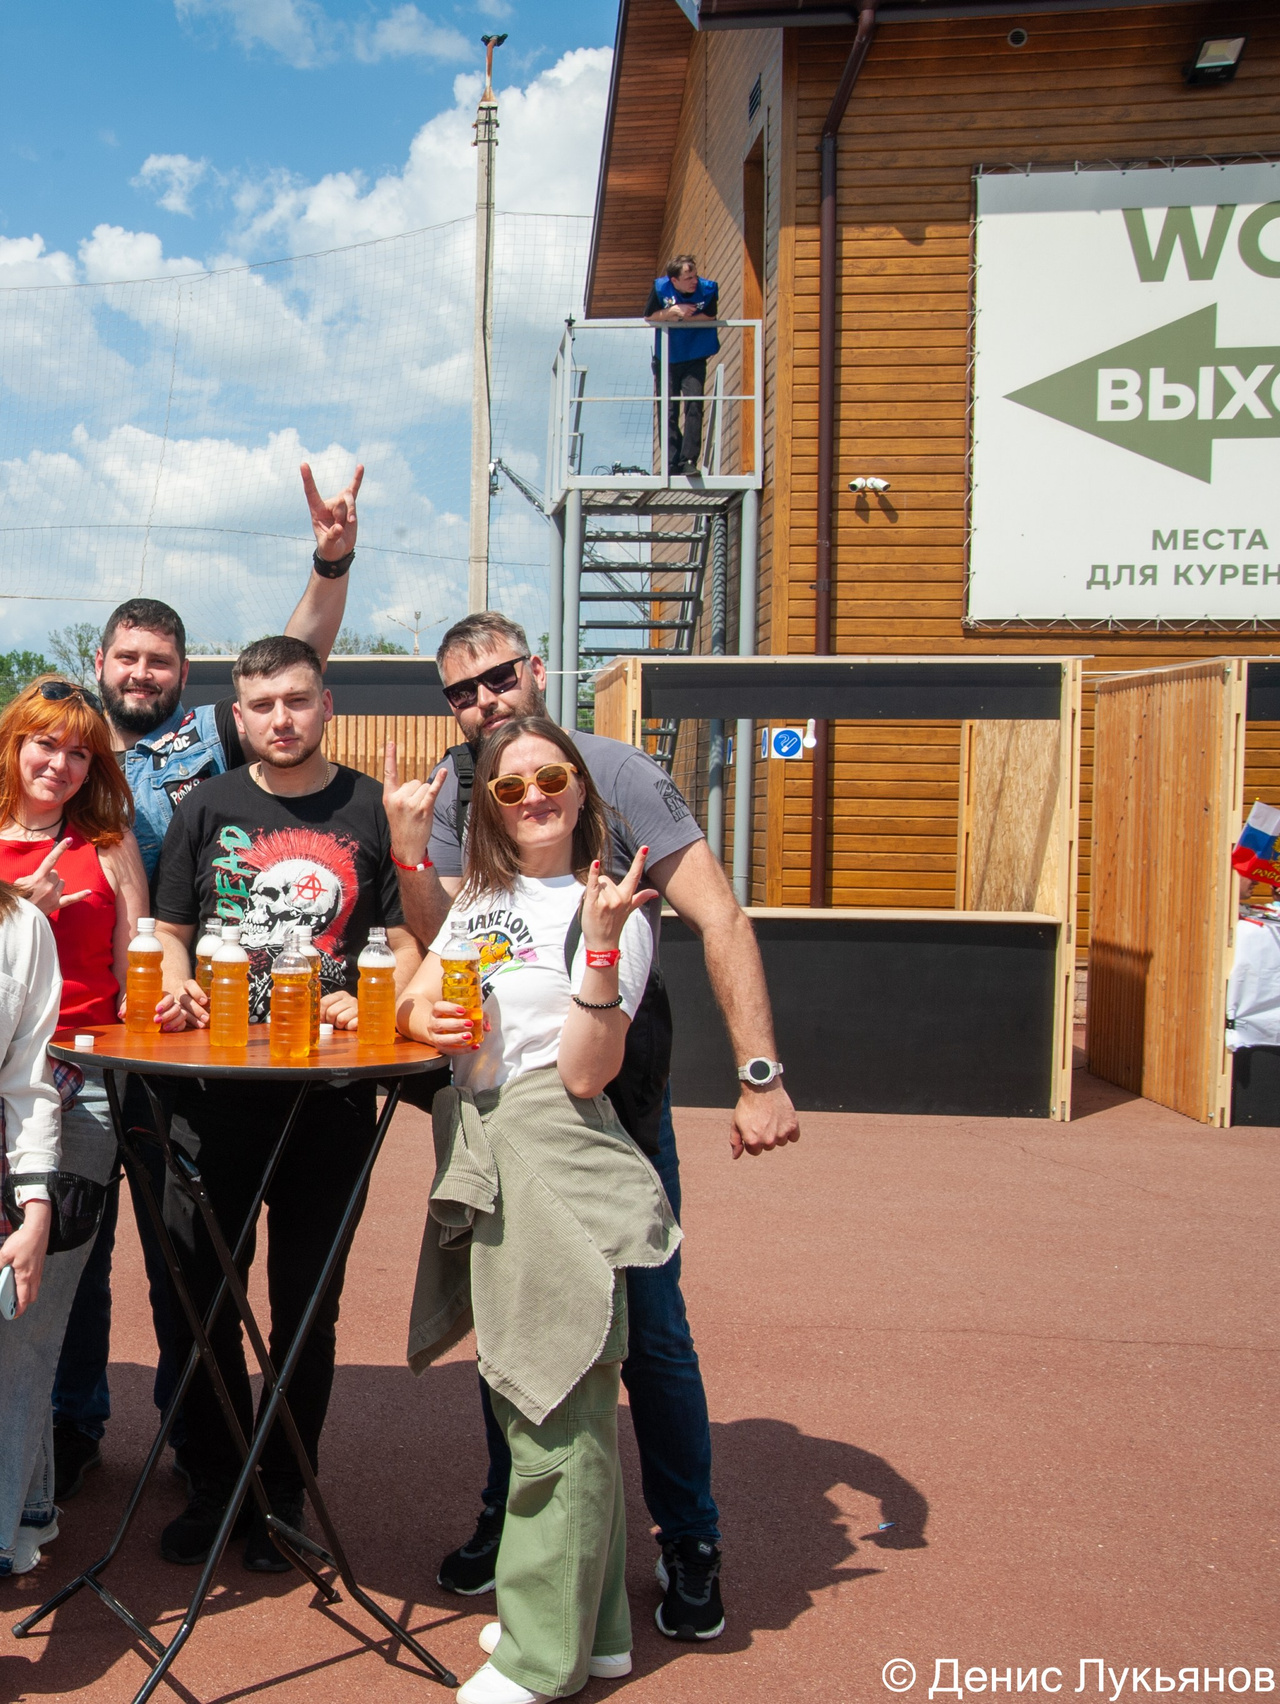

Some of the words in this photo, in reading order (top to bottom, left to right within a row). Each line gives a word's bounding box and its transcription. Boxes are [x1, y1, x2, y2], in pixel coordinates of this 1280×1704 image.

[1096, 364, 1280, 422] ВЫХ
[1151, 528, 1269, 550] МЕСТА
[1086, 564, 1158, 590] ДЛЯ
